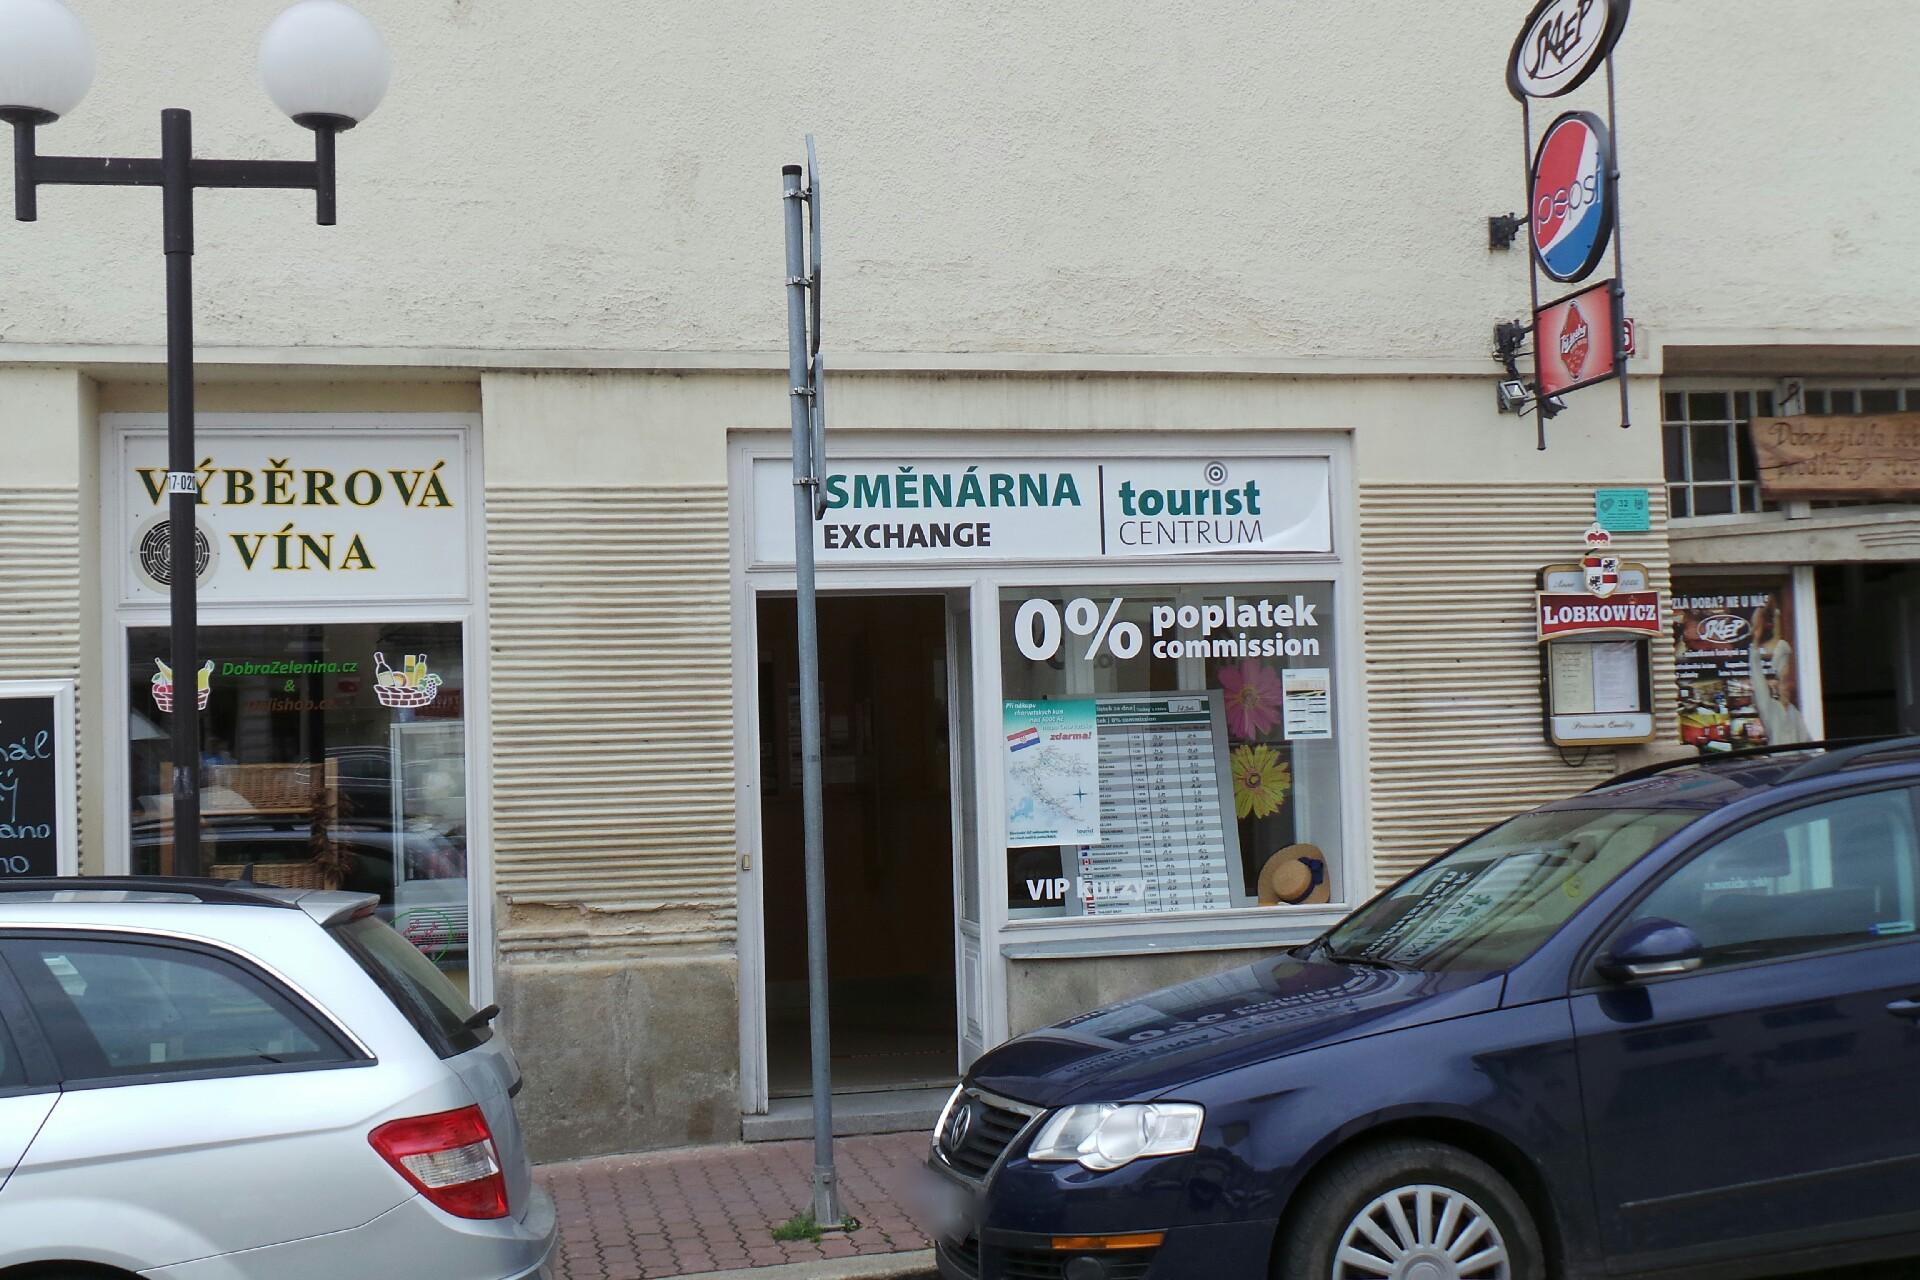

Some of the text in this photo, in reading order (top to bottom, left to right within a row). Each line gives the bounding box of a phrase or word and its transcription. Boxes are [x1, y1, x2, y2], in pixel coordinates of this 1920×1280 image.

[135, 457, 454, 507] VÝBĚROVÁ
[826, 465, 1081, 509] SMĚNÁRNA
[1118, 478, 1261, 516] tourist
[824, 522, 991, 549] EXCHANGE
[1119, 520, 1264, 545] CENTRUM
[229, 522, 376, 570] VÍNA
[1543, 604, 1656, 625] LOBKOWICZ
[1690, 596, 1724, 609] DOBA?
[1726, 596, 1739, 608] NE
[1014, 595, 1319, 661] 0% poplatek
[1152, 633, 1320, 659] commission
[222, 660, 358, 677] DobraZelenina.cz
[284, 679, 295, 692] &
[1049, 731, 1092, 740] zdarma!
[1026, 876, 1147, 901] VIP kurzy
